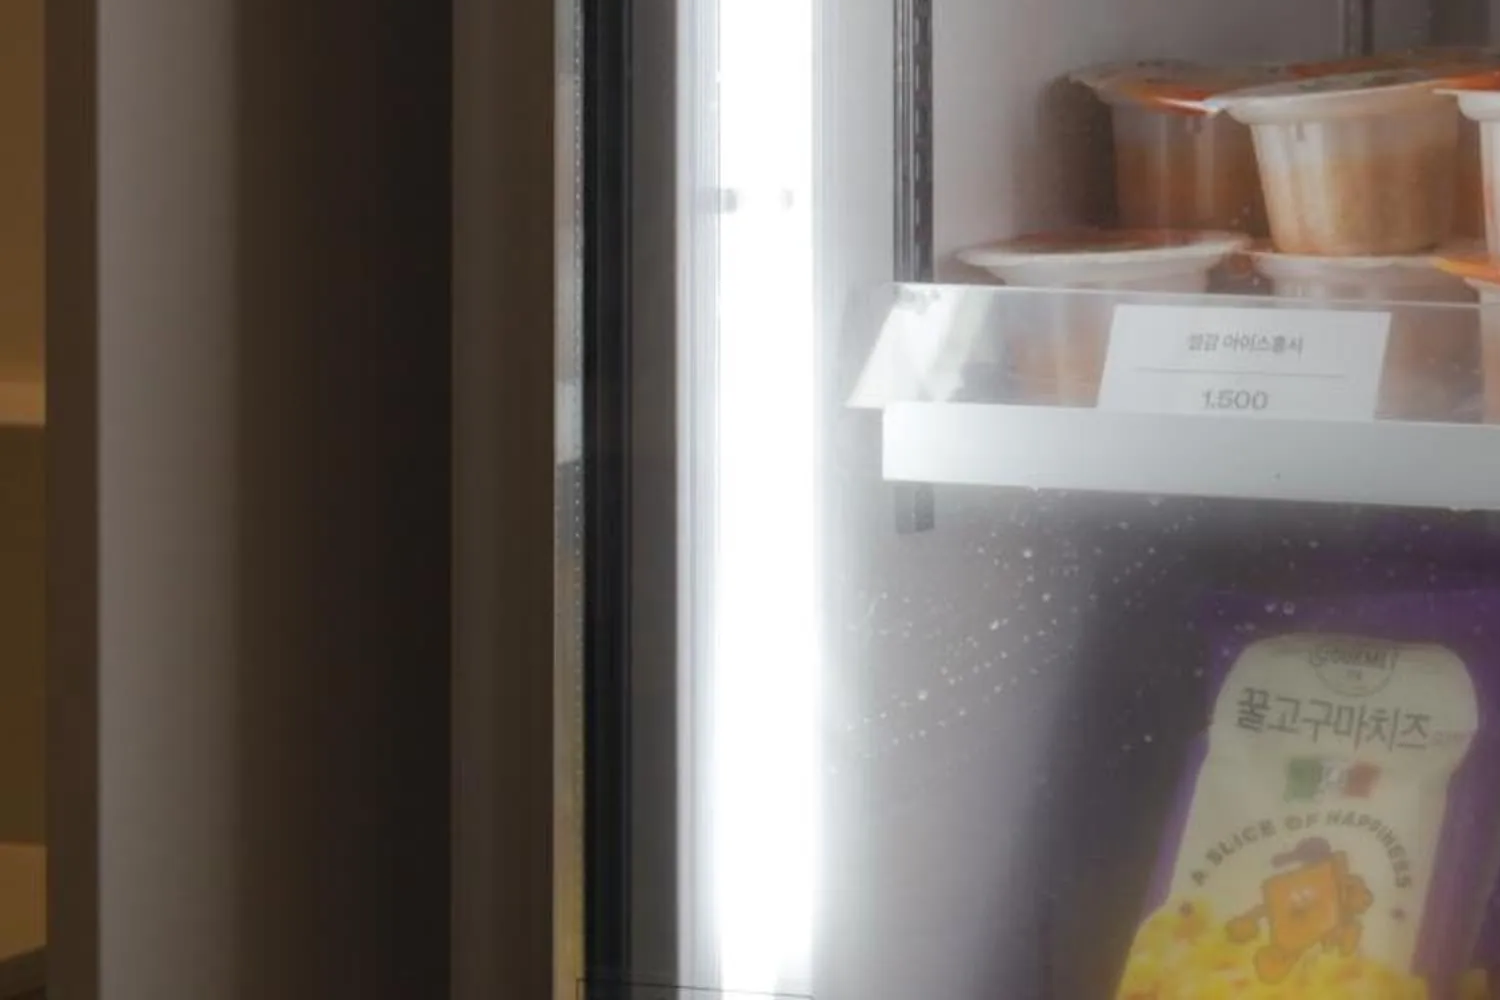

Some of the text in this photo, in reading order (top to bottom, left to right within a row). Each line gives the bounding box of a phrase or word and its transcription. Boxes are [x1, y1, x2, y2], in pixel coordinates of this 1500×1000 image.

[1222, 331, 1305, 357] 아이스홍시
[1235, 687, 1431, 752] 꿀고구마치즈
[1205, 819, 1277, 866] SLICE
[1285, 813, 1320, 831] OF
[1325, 809, 1414, 889] HAPPINESS
